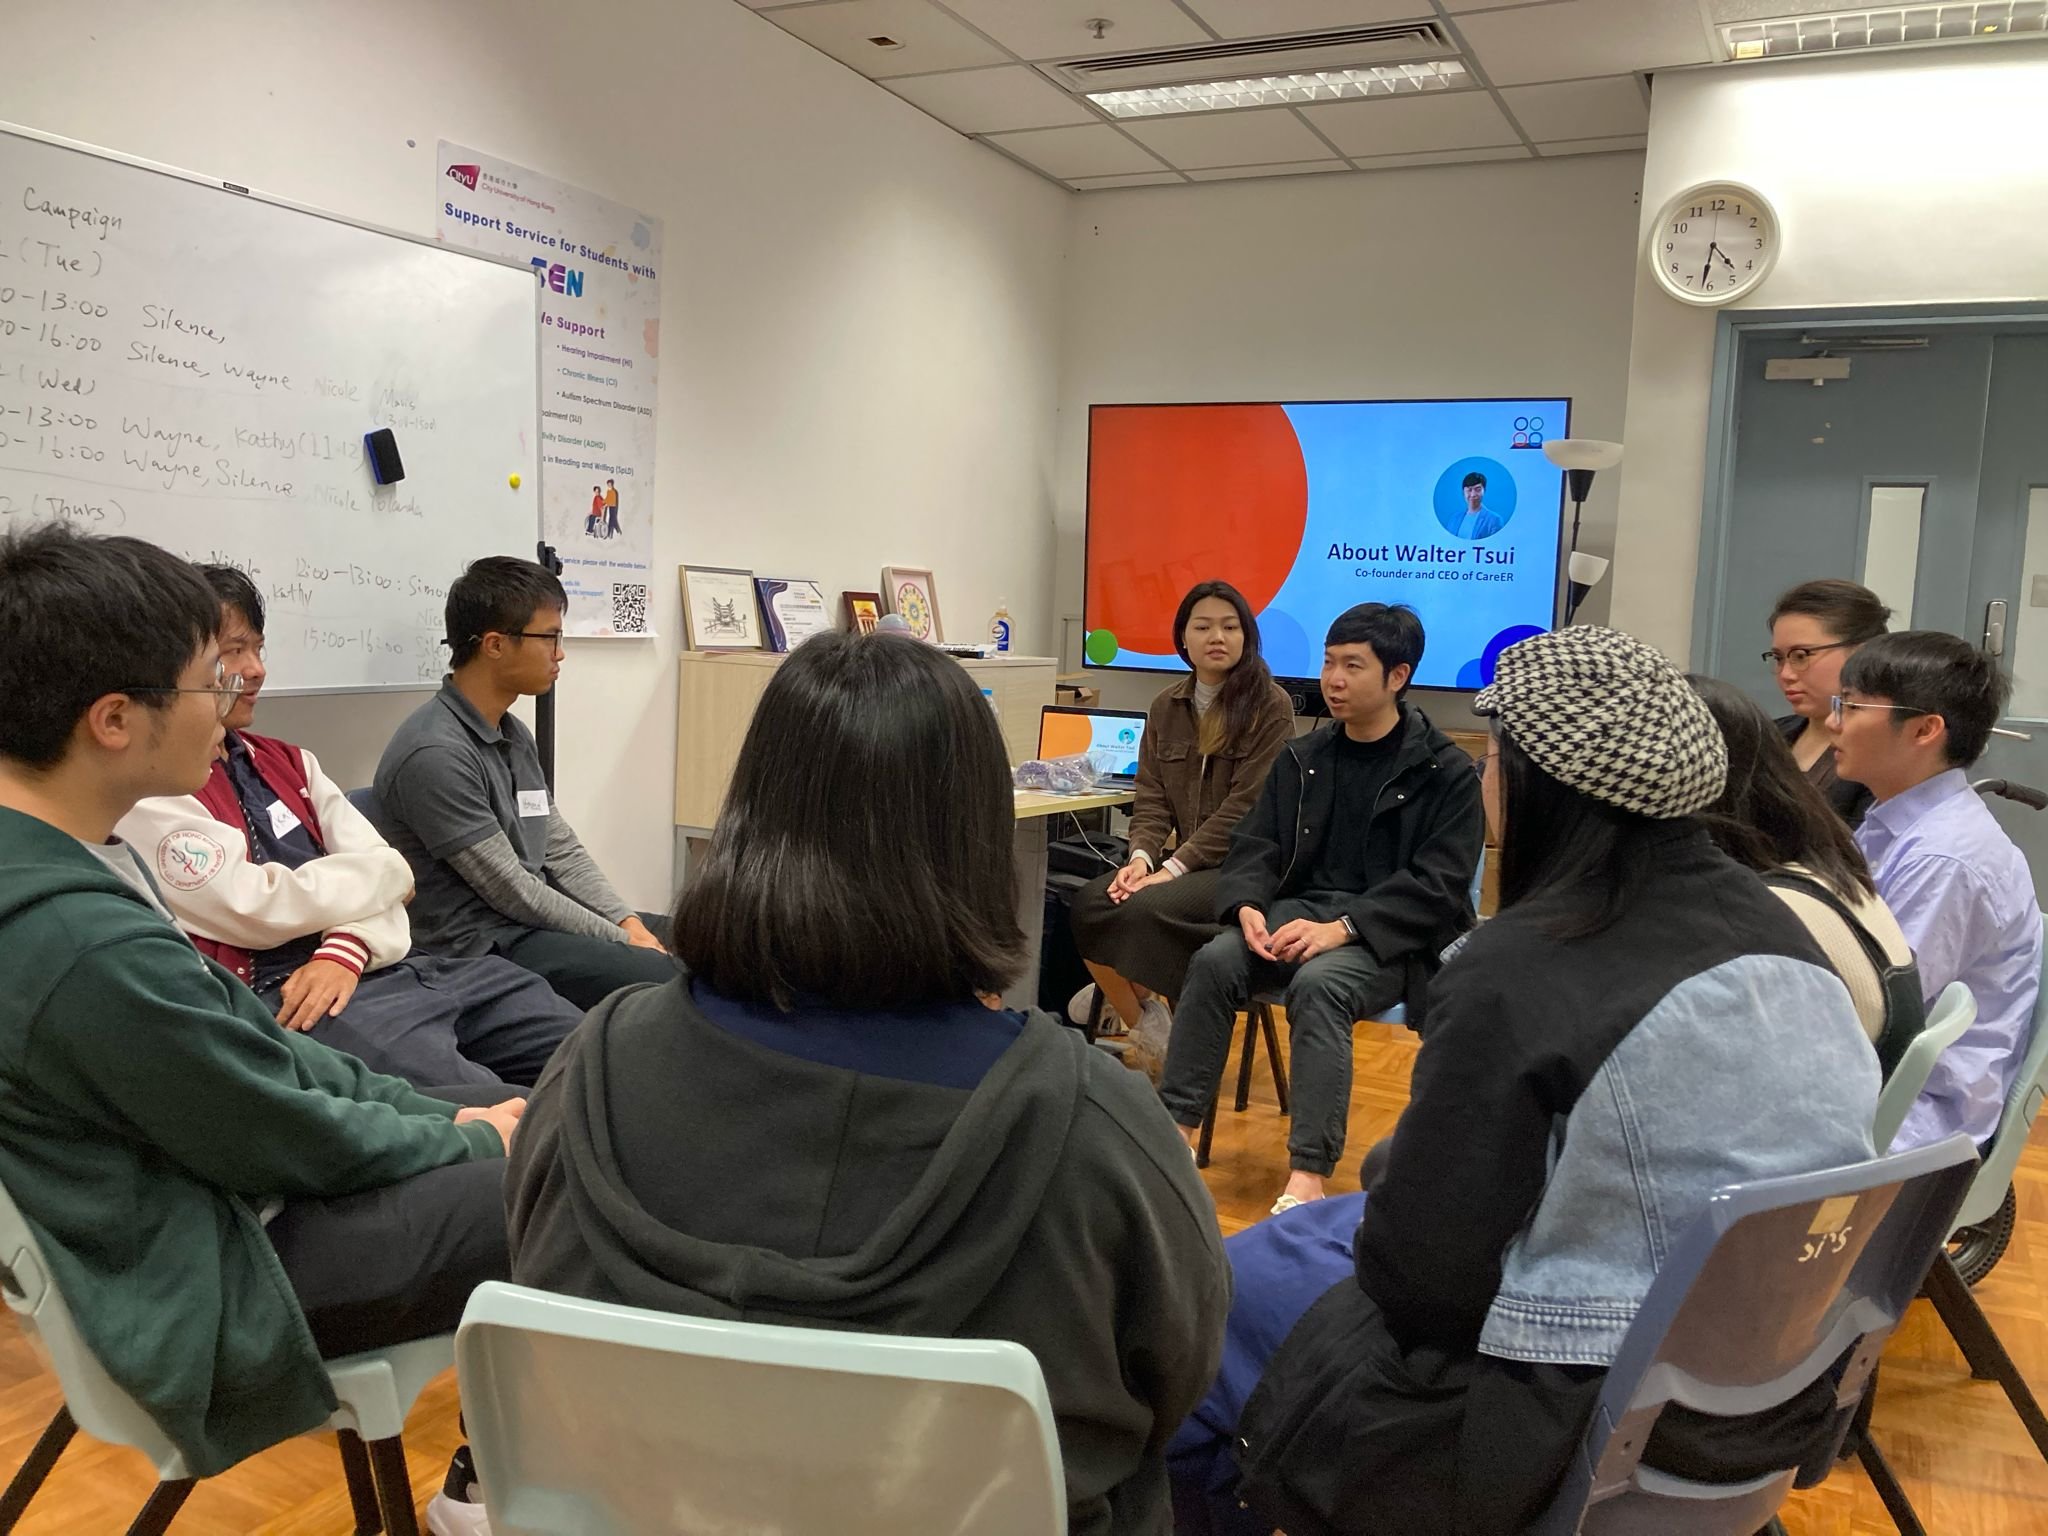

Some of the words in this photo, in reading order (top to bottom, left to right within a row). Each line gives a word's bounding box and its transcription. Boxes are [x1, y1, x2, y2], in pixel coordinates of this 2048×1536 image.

[1711, 200, 1725, 211] 12
[1735, 205, 1741, 215] 1
[23, 187, 122, 240] Campaign
[1690, 207, 1704, 217] 11
[1749, 217, 1758, 228] 2
[1673, 223, 1688, 234] 10
[445, 202, 501, 231] Support
[506, 222, 556, 247] Service
[560, 238, 577, 254] for
[580, 245, 629, 271] Students
[632, 263, 656, 280] with
[1754, 239, 1762, 249] 3
[1666, 243, 1674, 253] 9
[1671, 263, 1679, 273] 8
[1745, 260, 1753, 270] 4
[1686, 275, 1694, 286] 7
[1706, 280, 1714, 291] 6
[1728, 275, 1736, 286] 5
[557, 317, 605, 339] Support
[0, 318, 101, 351] 0-16:00
[561, 344, 586, 358] Hearing
[587, 350, 621, 365] Impairment
[562, 368, 585, 380] Chronic
[561, 391, 582, 401] Autism
[583, 395, 612, 408] Spectrum
[613, 401, 637, 413] Disorder
[558, 434, 582, 446] Disorder
[547, 455, 554, 463] in
[555, 456, 580, 469] Reading
[582, 461, 593, 469] and
[1327, 543, 1389, 561] About
[1395, 544, 1466, 564] Walter
[1473, 547, 1514, 565] Tsui
[1355, 568, 1412, 580] Co-founder
[1415, 569, 1435, 580] and
[1438, 570, 1459, 581] CEO
[1462, 570, 1473, 581] of
[1476, 571, 1514, 582] CareER
